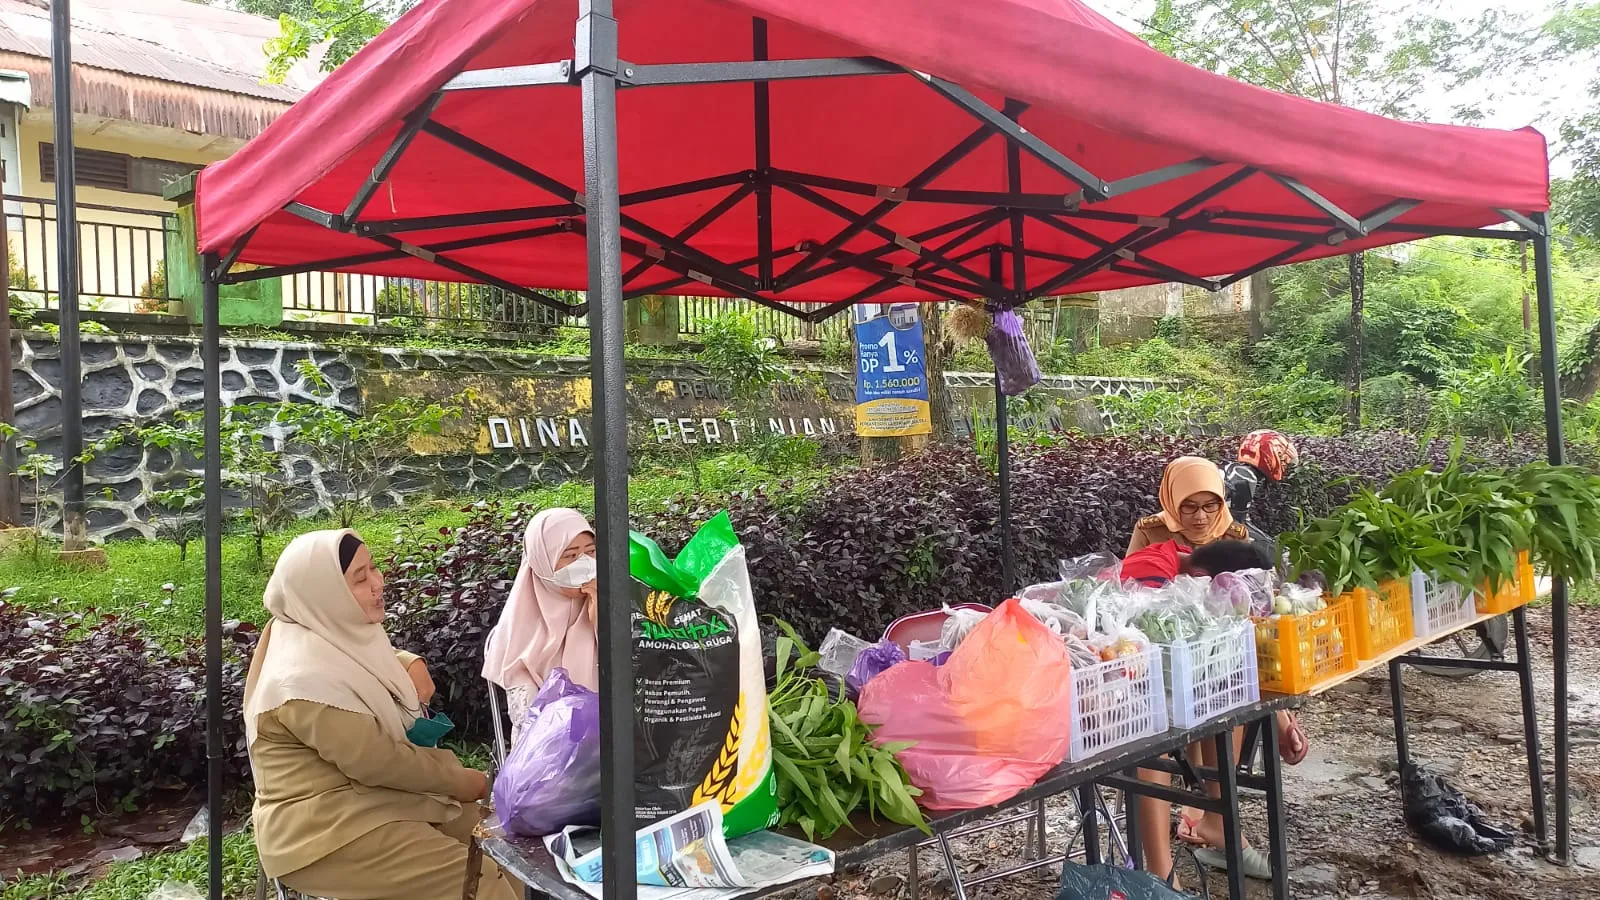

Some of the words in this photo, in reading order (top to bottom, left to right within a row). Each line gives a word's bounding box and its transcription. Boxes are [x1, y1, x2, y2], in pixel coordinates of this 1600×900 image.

[861, 359, 879, 373] DP
[875, 376, 920, 389] 1.560.000
[677, 696, 706, 705] Pengawet
[644, 707, 687, 716] Menggunakan
